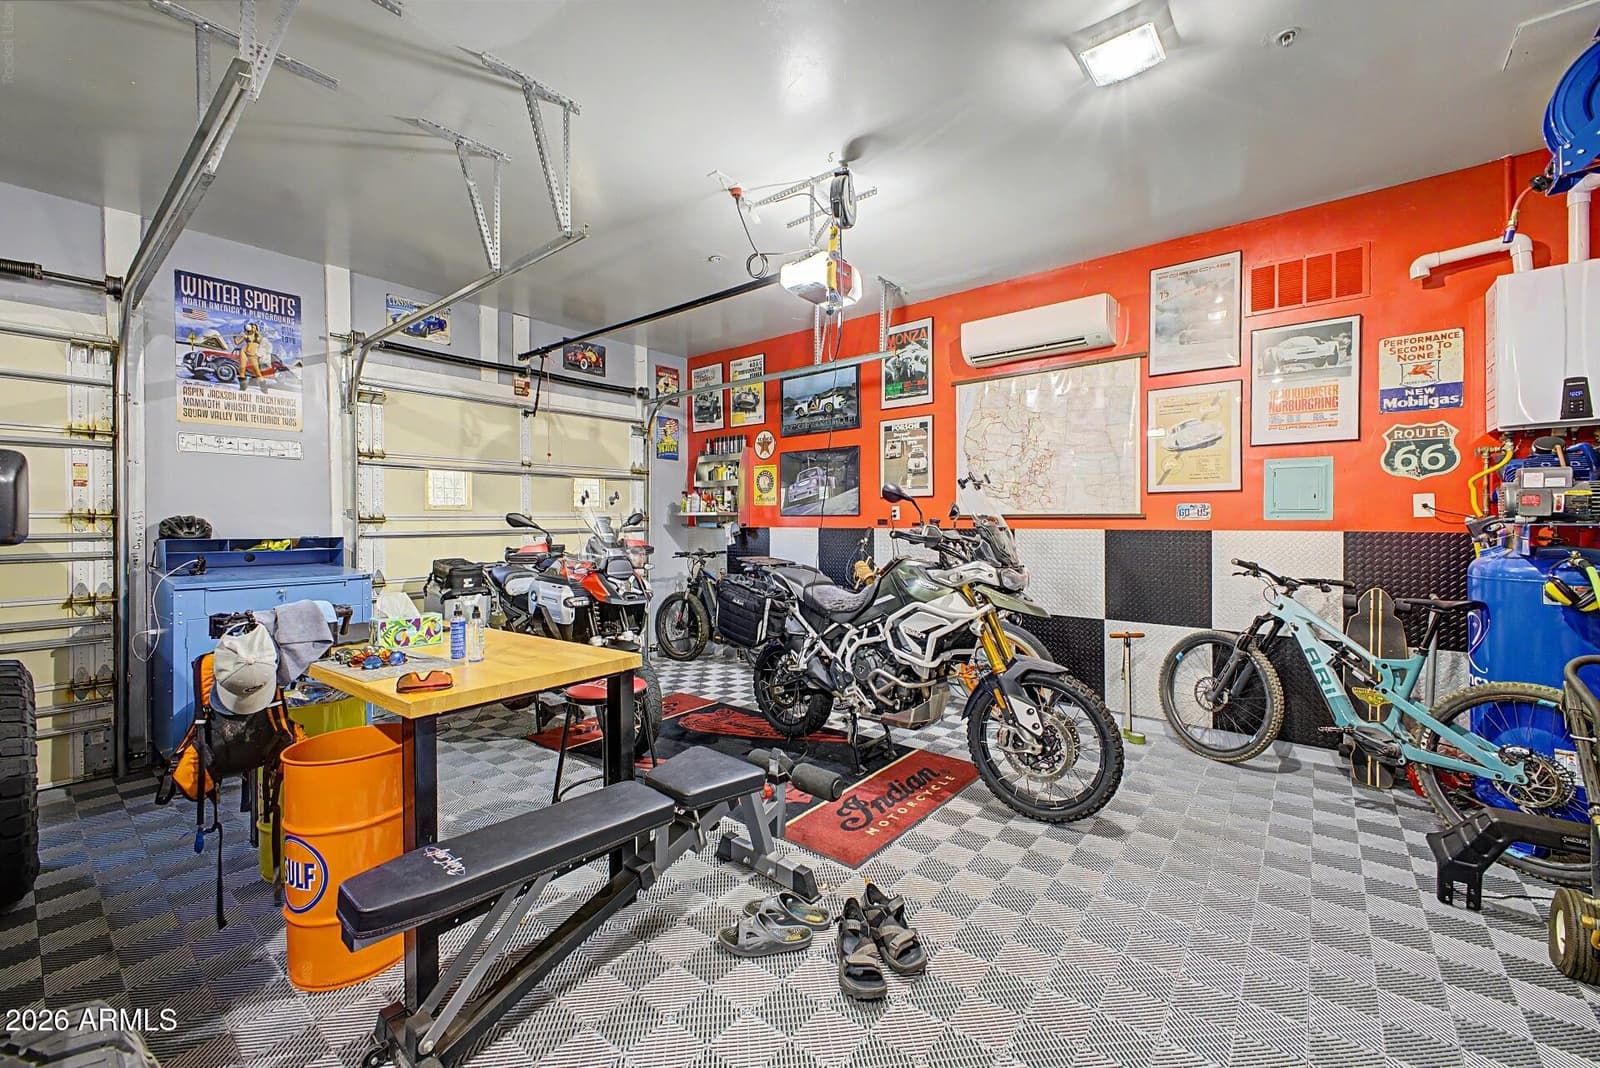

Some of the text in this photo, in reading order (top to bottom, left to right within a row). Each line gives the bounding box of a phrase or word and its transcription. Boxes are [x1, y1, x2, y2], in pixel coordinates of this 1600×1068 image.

[180, 274, 296, 317] WINTER SPORTS
[182, 296, 207, 309] NORTH
[887, 327, 928, 347] MONZA
[1383, 331, 1461, 348] PERFORMANCE
[1389, 340, 1452, 356] SECOND TO
[182, 386, 205, 398] ASPEN
[207, 389, 237, 401] JACKSON
[1404, 386, 1436, 396] NEW
[182, 398, 221, 410] MAMMOTH
[1383, 394, 1460, 409] Mobilgas
[182, 407, 209, 419] SQUAW
[210, 410, 233, 421] VALLEY
[234, 412, 249, 423] VAIL
[1393, 426, 1447, 439] ROUTE
[1394, 443, 1446, 471] 66
[1304, 647, 1337, 695] ARI
[836, 767, 940, 832] Indian
[864, 775, 956, 836] MOTORCYCLE
